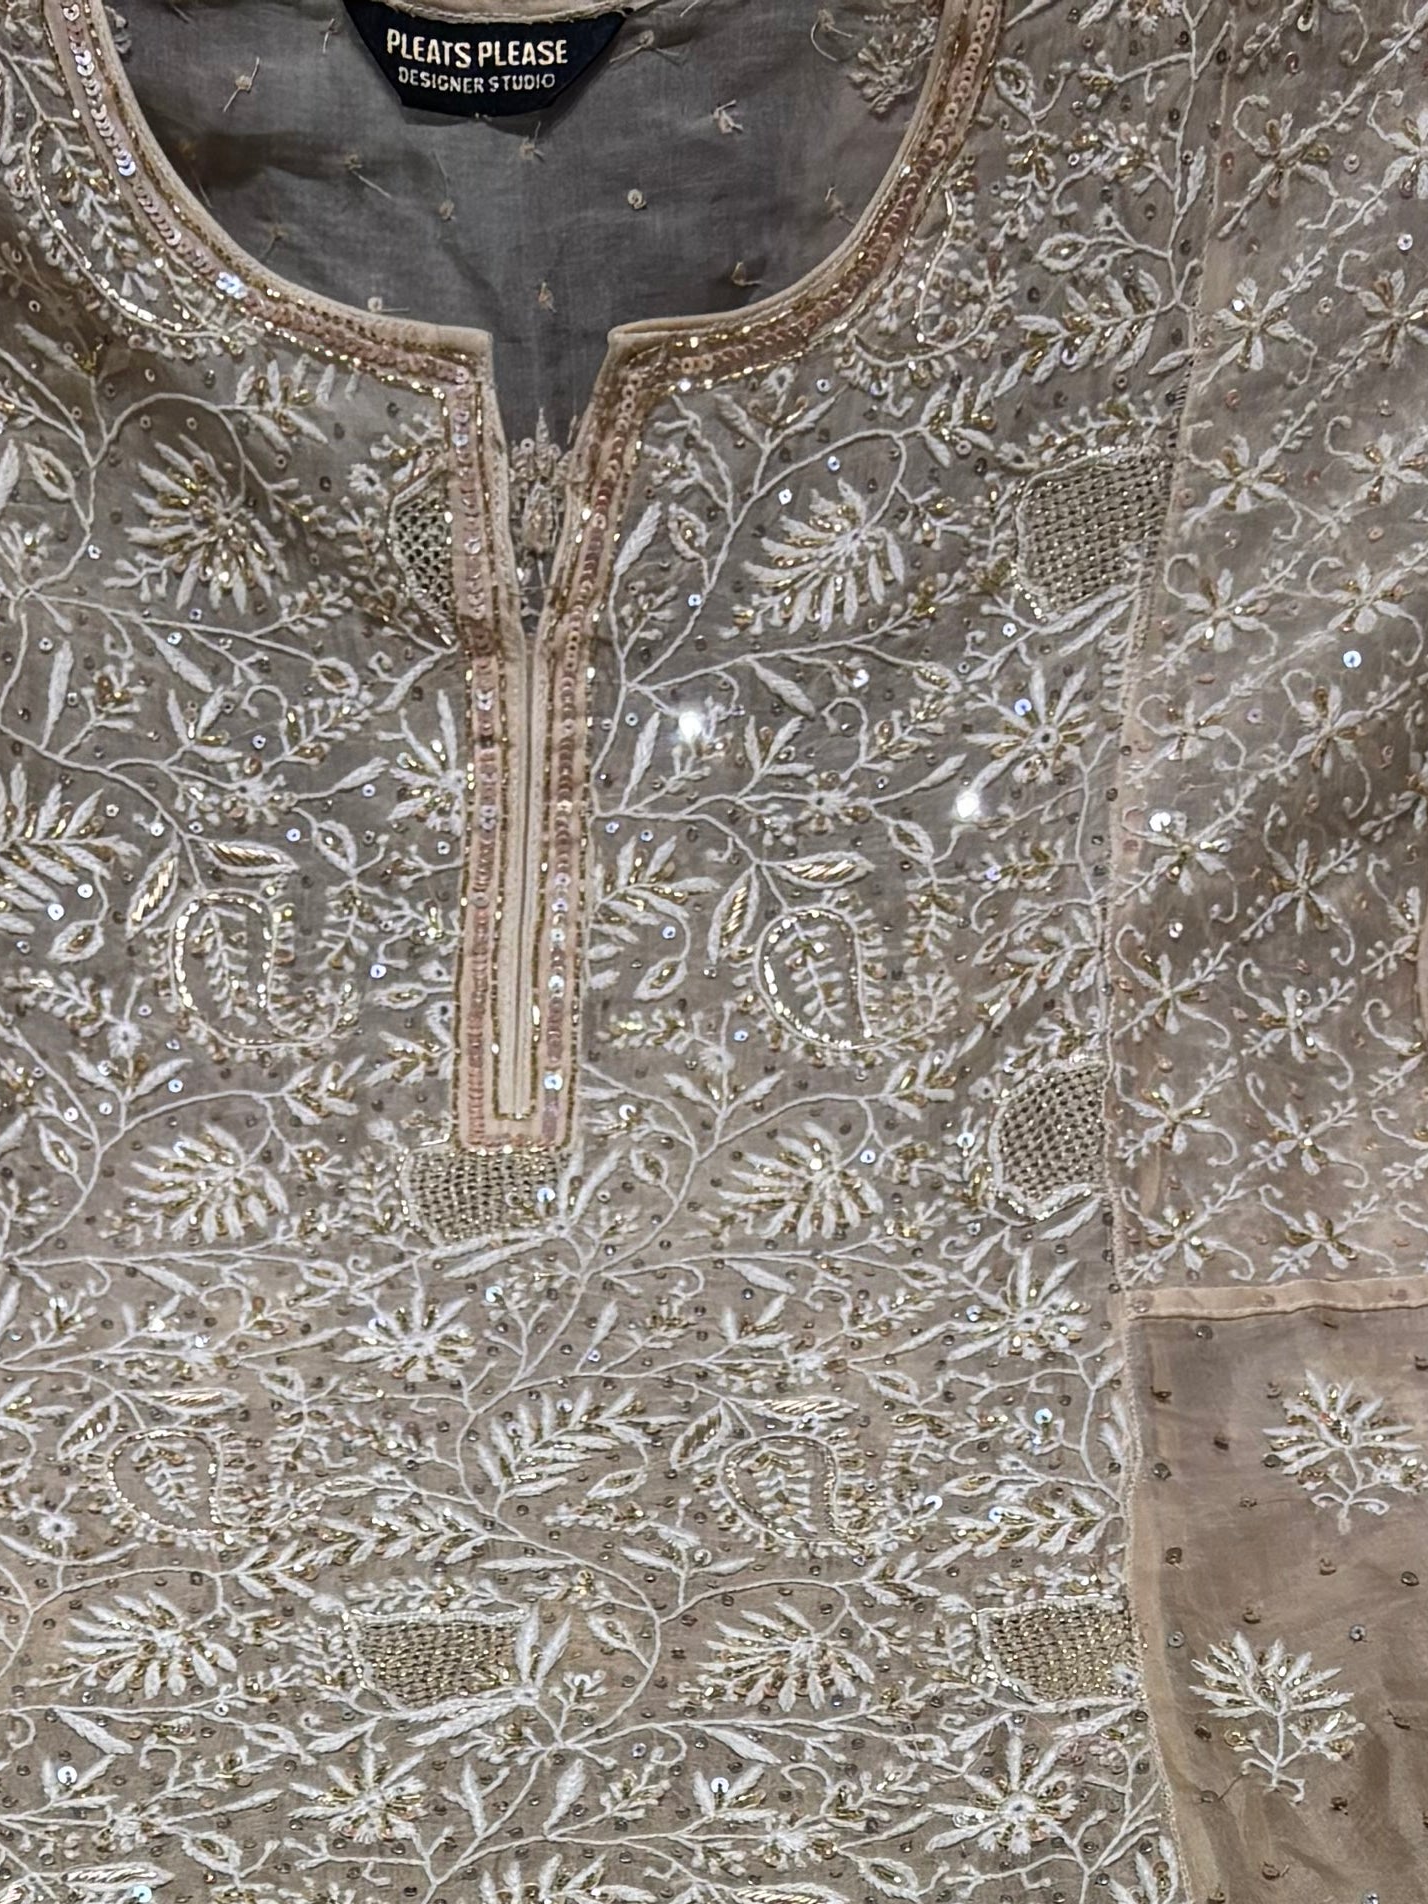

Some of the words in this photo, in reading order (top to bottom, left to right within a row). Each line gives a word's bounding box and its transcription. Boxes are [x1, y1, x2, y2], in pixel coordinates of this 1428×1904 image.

[386, 28, 471, 68] PLEATS
[478, 39, 568, 67] PLEASE
[398, 66, 484, 94] DESIGNER
[489, 73, 556, 92] STUDIO
